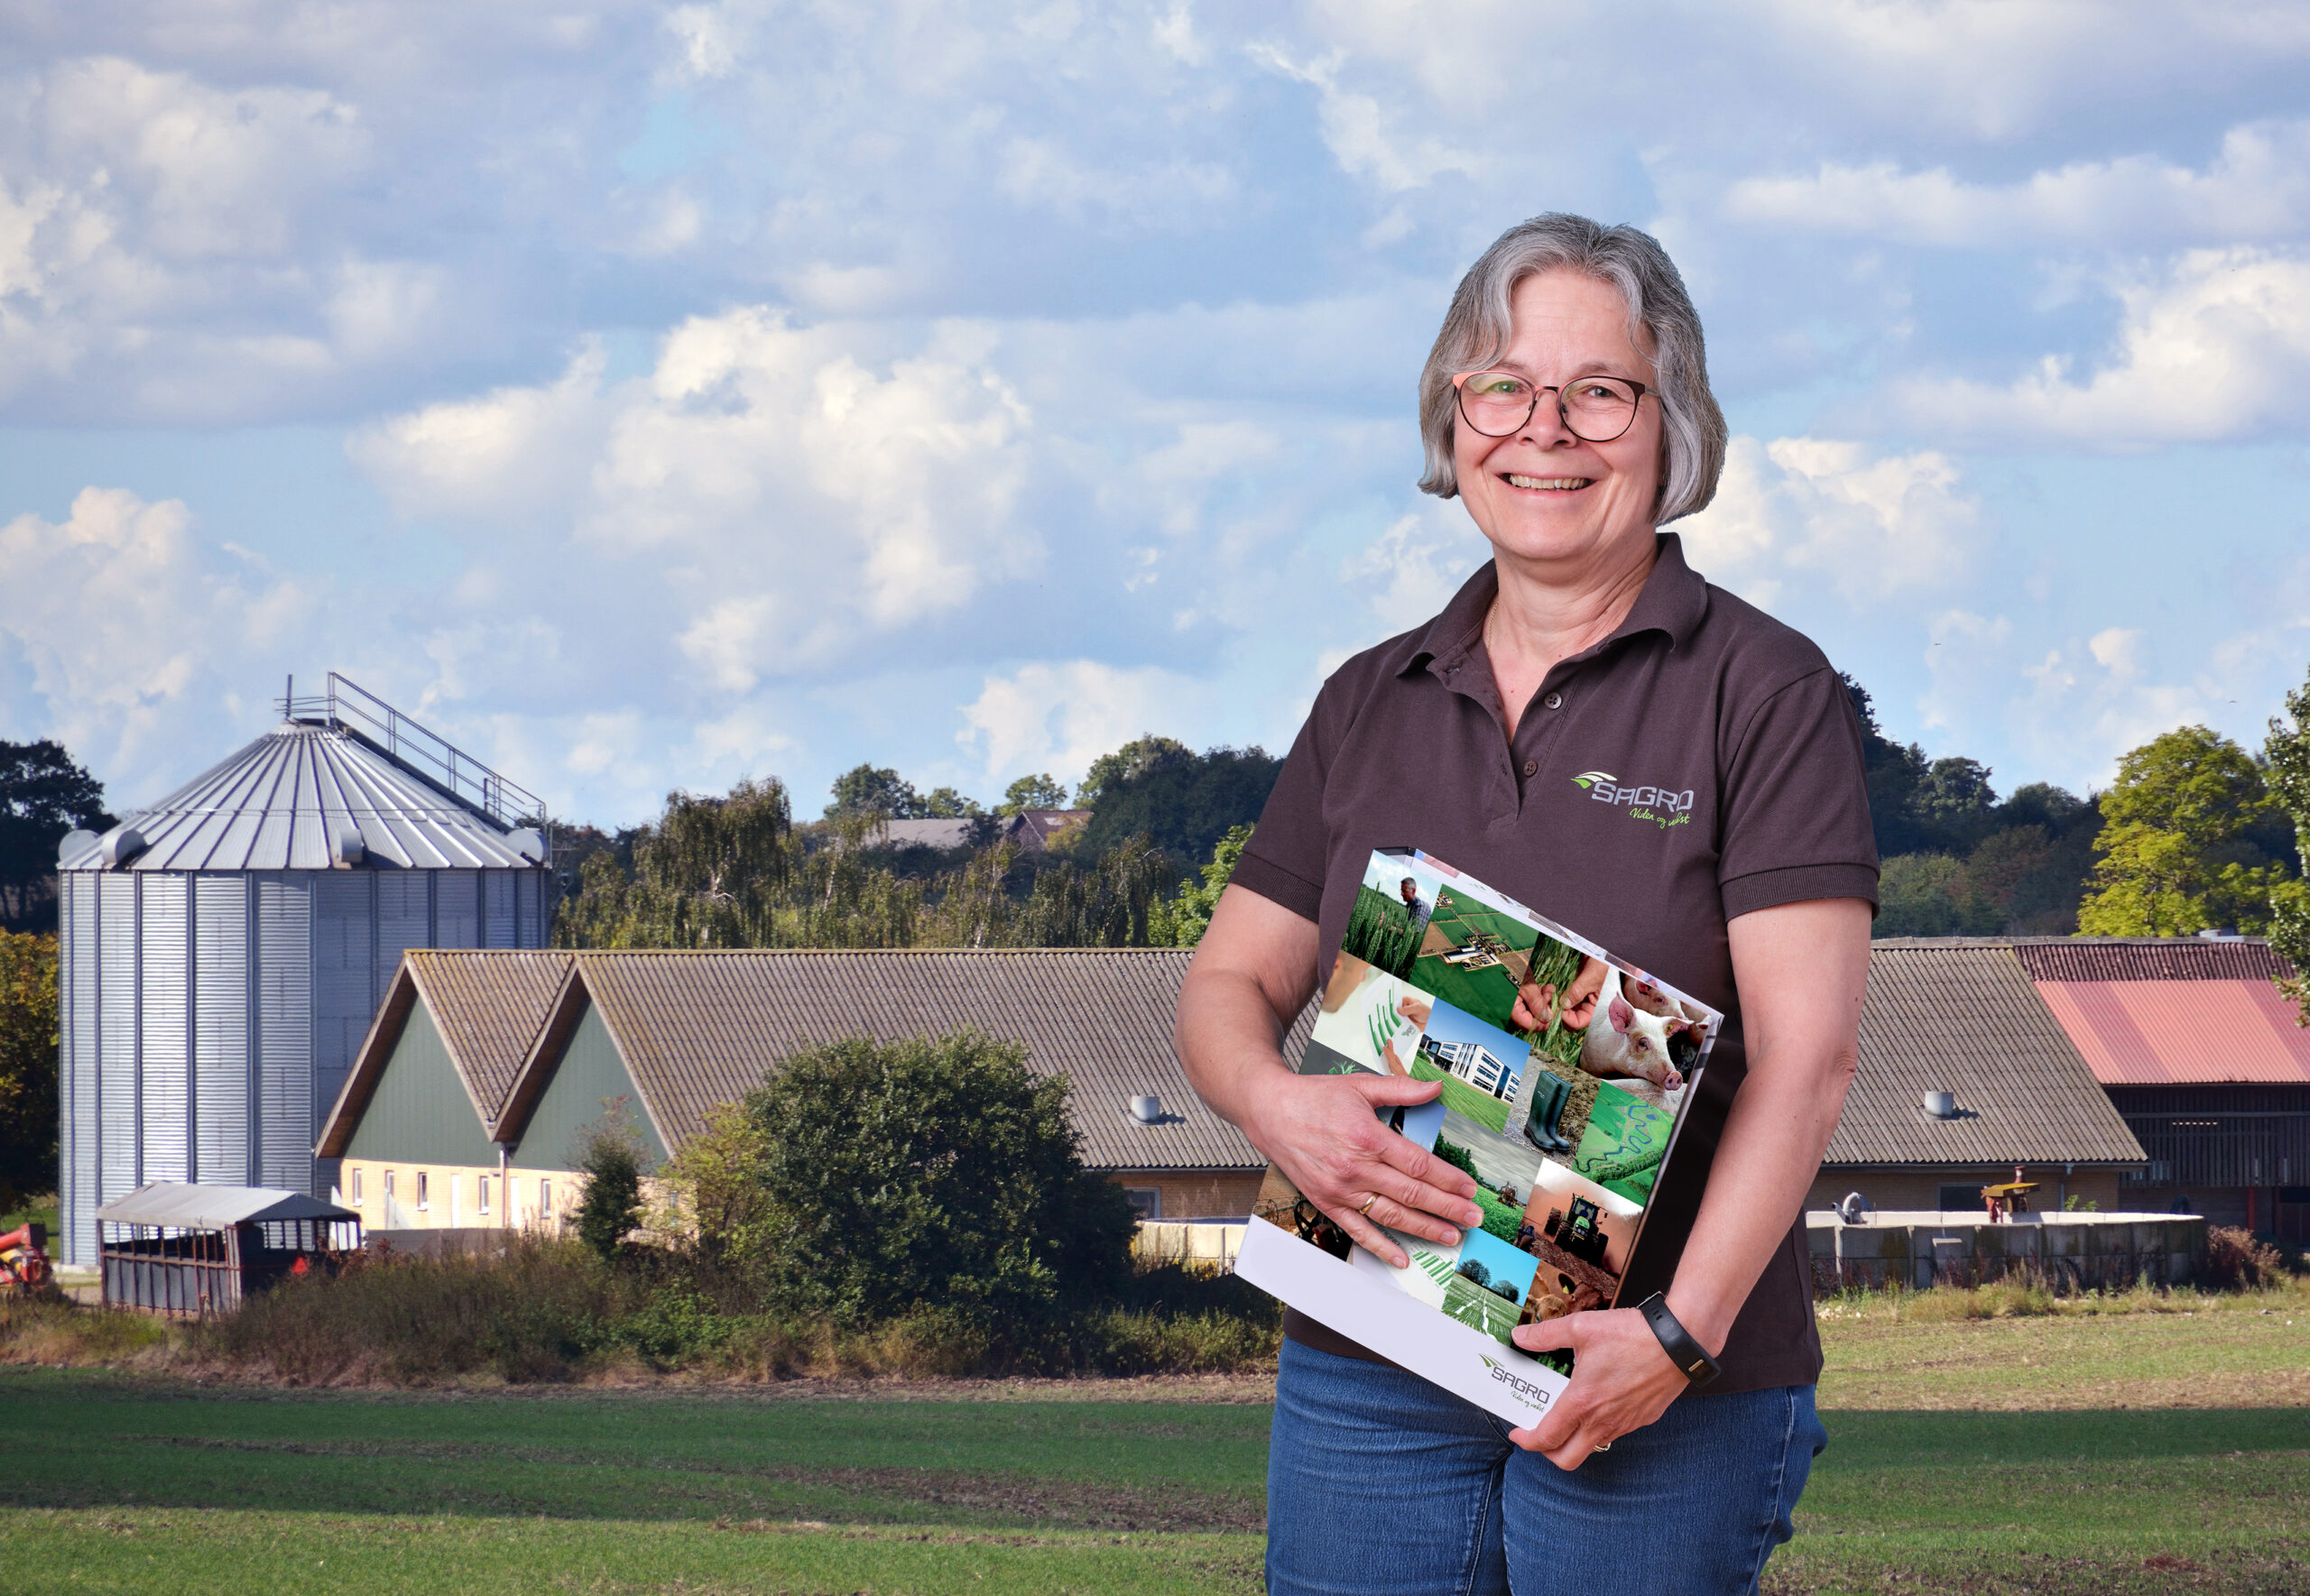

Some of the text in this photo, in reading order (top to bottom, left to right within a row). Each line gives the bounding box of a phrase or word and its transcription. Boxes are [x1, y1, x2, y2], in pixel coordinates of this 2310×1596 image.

[1591, 781, 1695, 812] SAGRO
[1629, 807, 1655, 821] Viden
[1656, 816, 1668, 829] og
[1492, 1366, 1550, 1404] SAGRO
